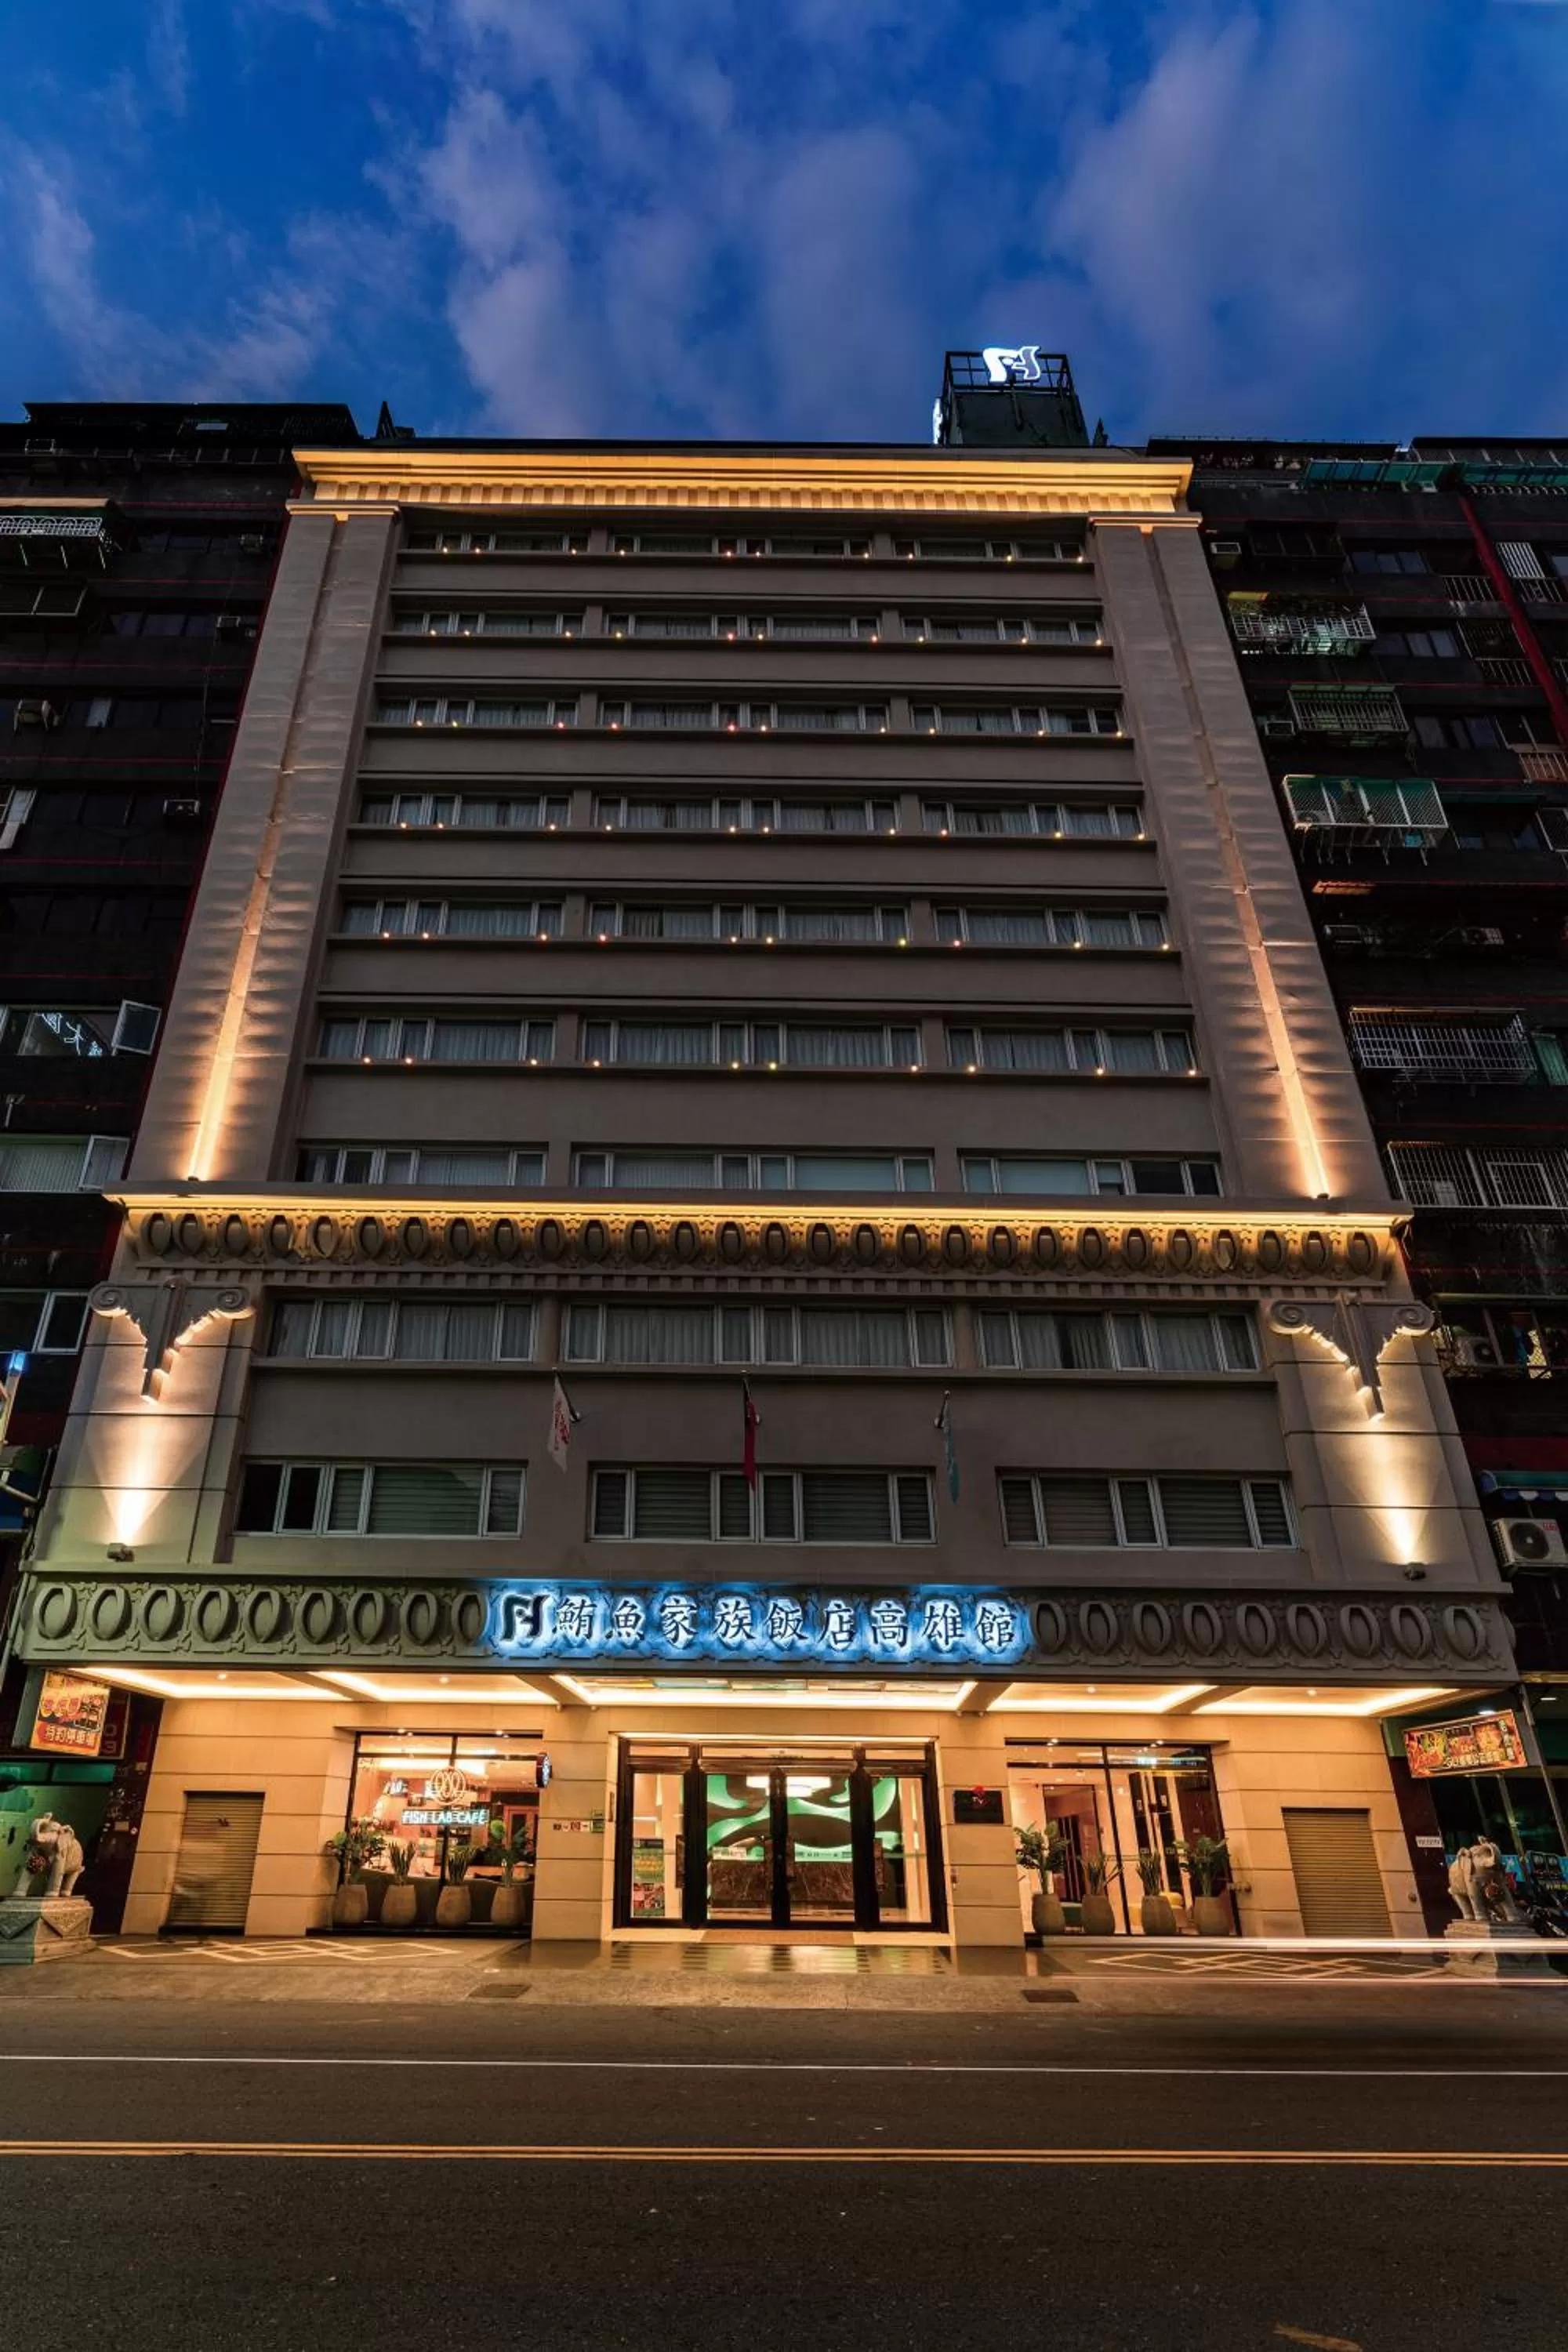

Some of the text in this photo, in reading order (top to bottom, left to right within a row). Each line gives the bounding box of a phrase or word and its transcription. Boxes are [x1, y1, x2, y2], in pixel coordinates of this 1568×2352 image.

[552, 1597, 1017, 1647] 鮪魚家族飯店高雄館
[402, 1810, 427, 1824] FISH
[432, 1810, 452, 1824] LAB
